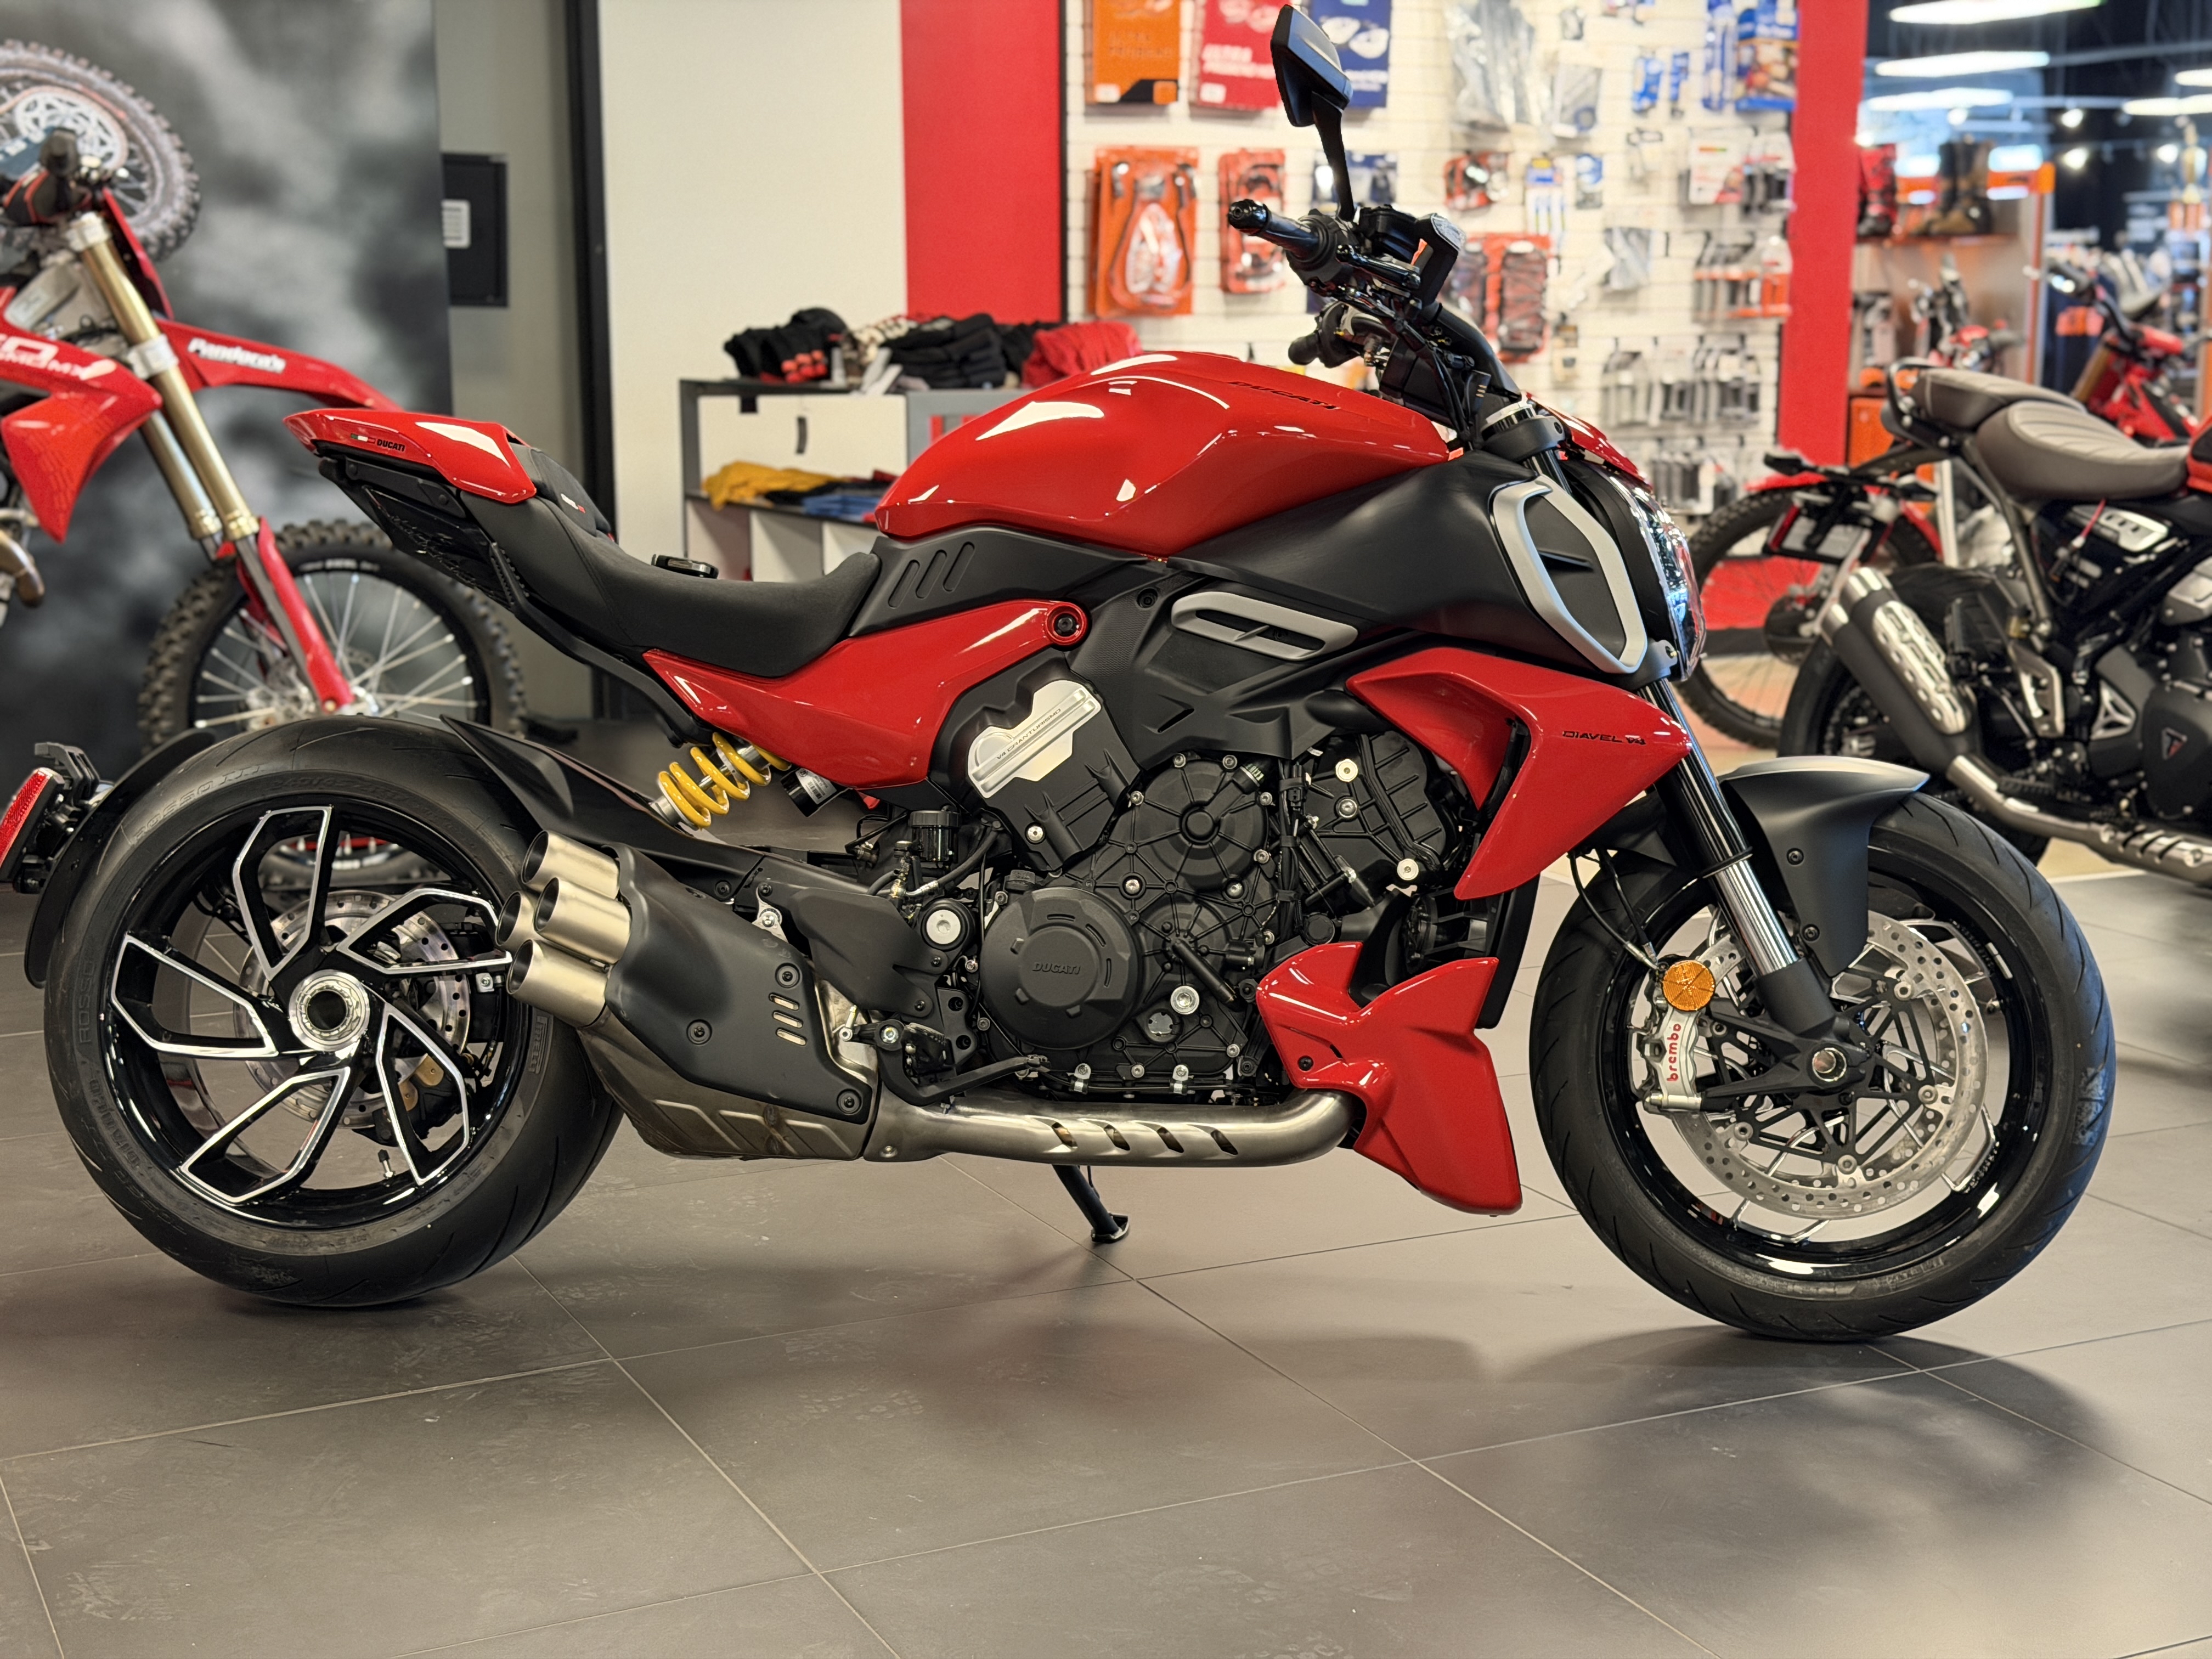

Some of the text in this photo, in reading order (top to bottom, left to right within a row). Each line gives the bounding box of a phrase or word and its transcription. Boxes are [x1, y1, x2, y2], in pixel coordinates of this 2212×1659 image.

[1227, 381, 1339, 409] DUCATI
[376, 438, 405, 452] DUCATI
[996, 708, 1062, 760] V4 GRANTURISMO
[1562, 730, 1646, 746] DIAVEL V4
[1032, 962, 1081, 975] DUCATI
[78, 958, 96, 1044] ROSSO
[1666, 1023, 1681, 1081] brembo
